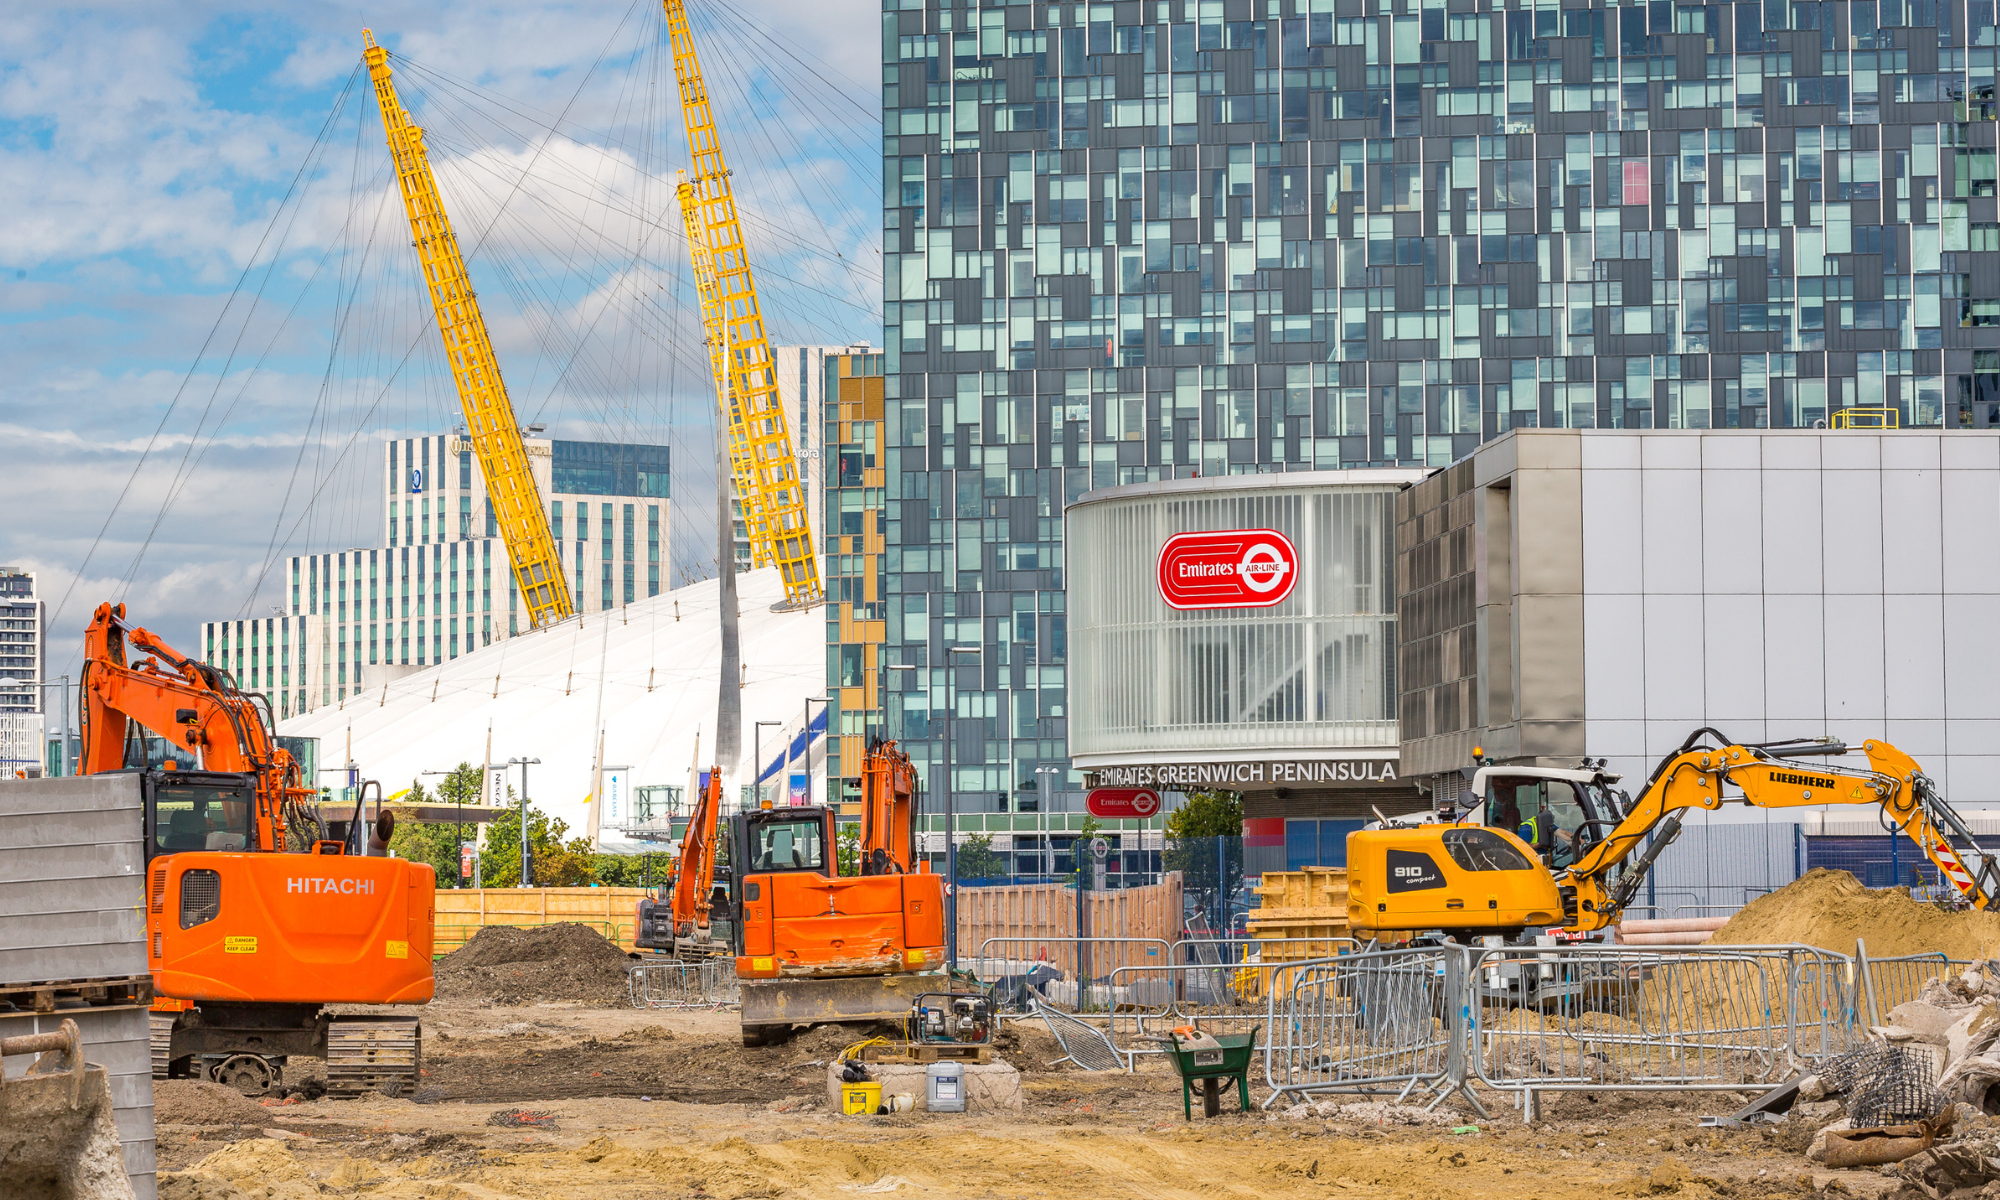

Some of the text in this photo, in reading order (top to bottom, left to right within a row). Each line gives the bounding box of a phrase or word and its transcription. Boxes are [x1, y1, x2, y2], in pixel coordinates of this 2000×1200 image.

[793, 448, 819, 458] Arora
[1179, 561, 1234, 578] Emirates
[1100, 762, 1397, 786] EMIRATES GREENWICH PENINSULA
[1769, 771, 1836, 789] LIEBHERR
[1394, 866, 1422, 877] 910
[1405, 874, 1436, 884] compact
[287, 877, 375, 895] HITACHI
